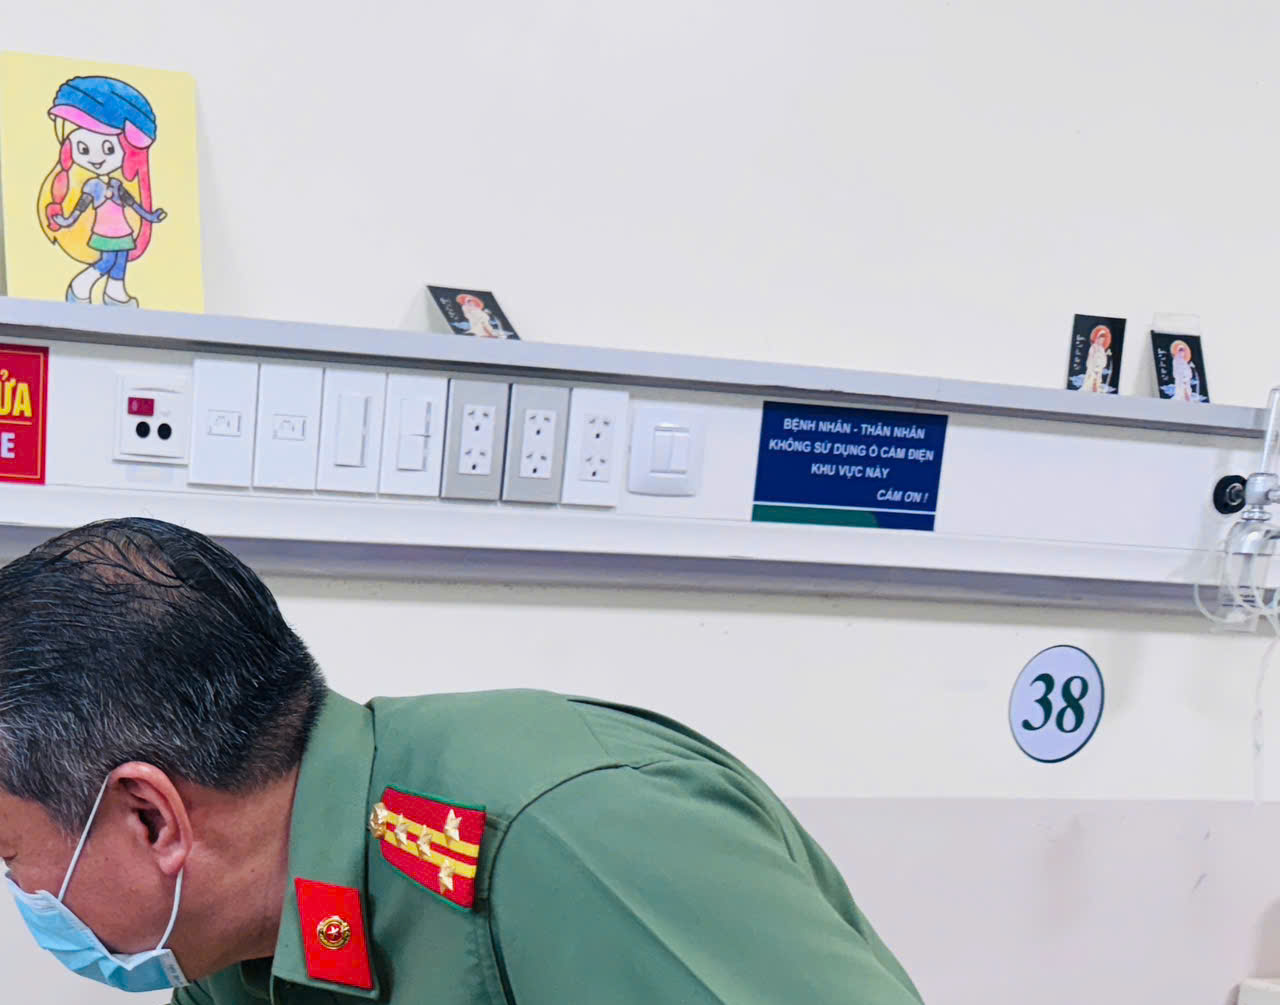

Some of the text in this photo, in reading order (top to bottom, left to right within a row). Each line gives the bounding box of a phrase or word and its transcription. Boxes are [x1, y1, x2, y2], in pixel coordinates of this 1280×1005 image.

[783, 417, 816, 432] BỆNH
[818, 419, 852, 434] NHÂN
[861, 422, 891, 437] THÂN
[893, 425, 926, 439] NHÂN
[768, 437, 812, 453] KHÔNG
[833, 443, 867, 458] DỤNG
[811, 463, 836, 475] KHU
[838, 465, 863, 479] VỰC
[1022, 673, 1088, 733] 38
